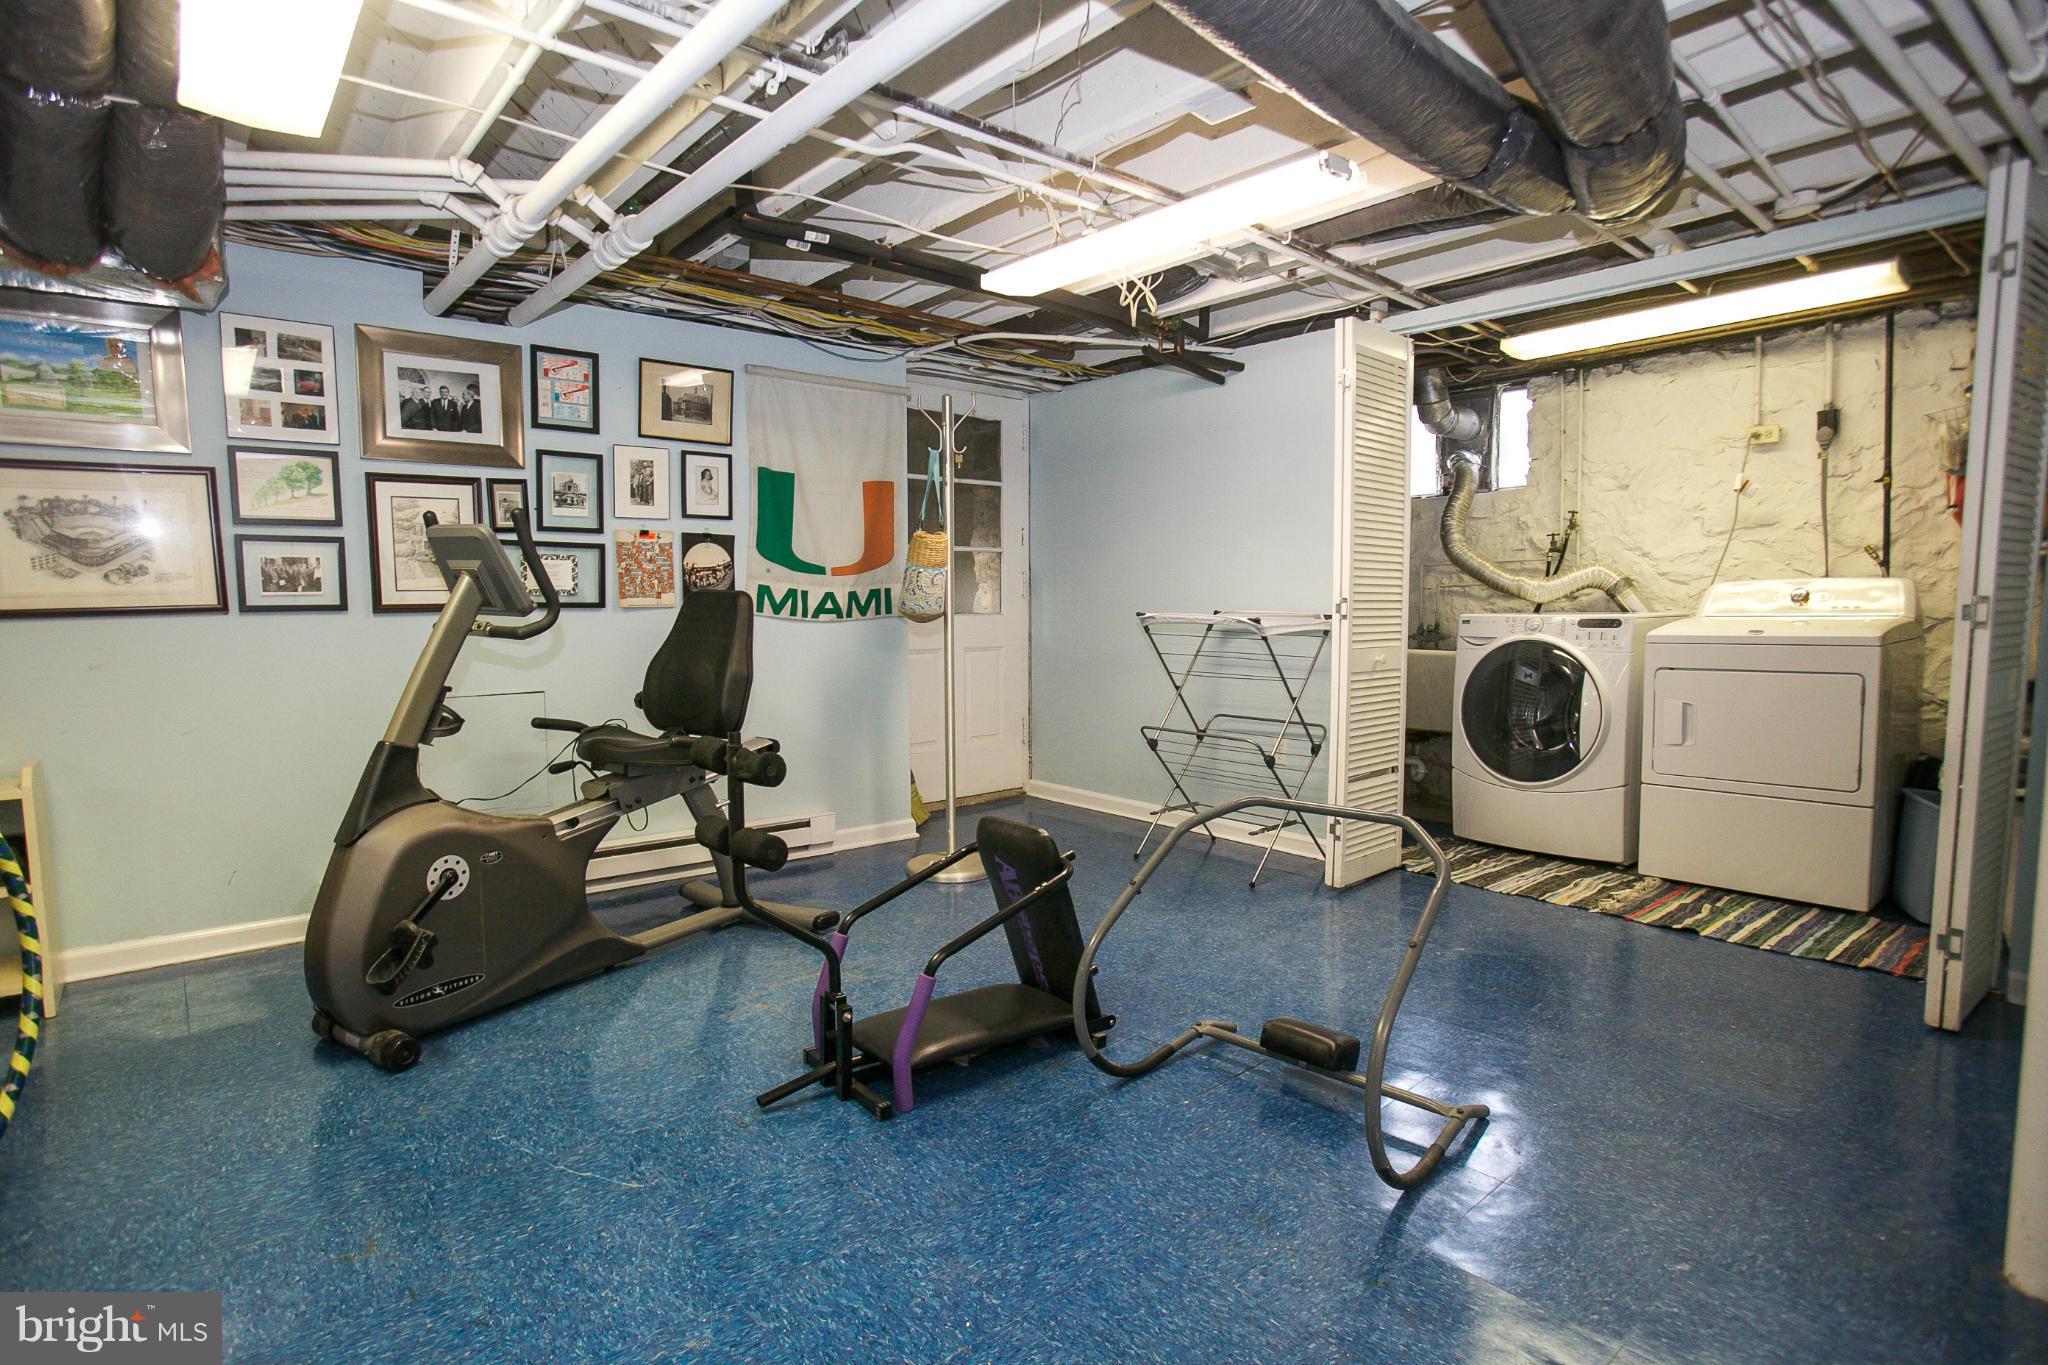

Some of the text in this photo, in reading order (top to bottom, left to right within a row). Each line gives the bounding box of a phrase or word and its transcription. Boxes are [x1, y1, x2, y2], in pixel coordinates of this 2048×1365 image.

[756, 467, 895, 577] U
[756, 584, 893, 619] MIAMI
[400, 975, 480, 1006] VISION FITNESS
